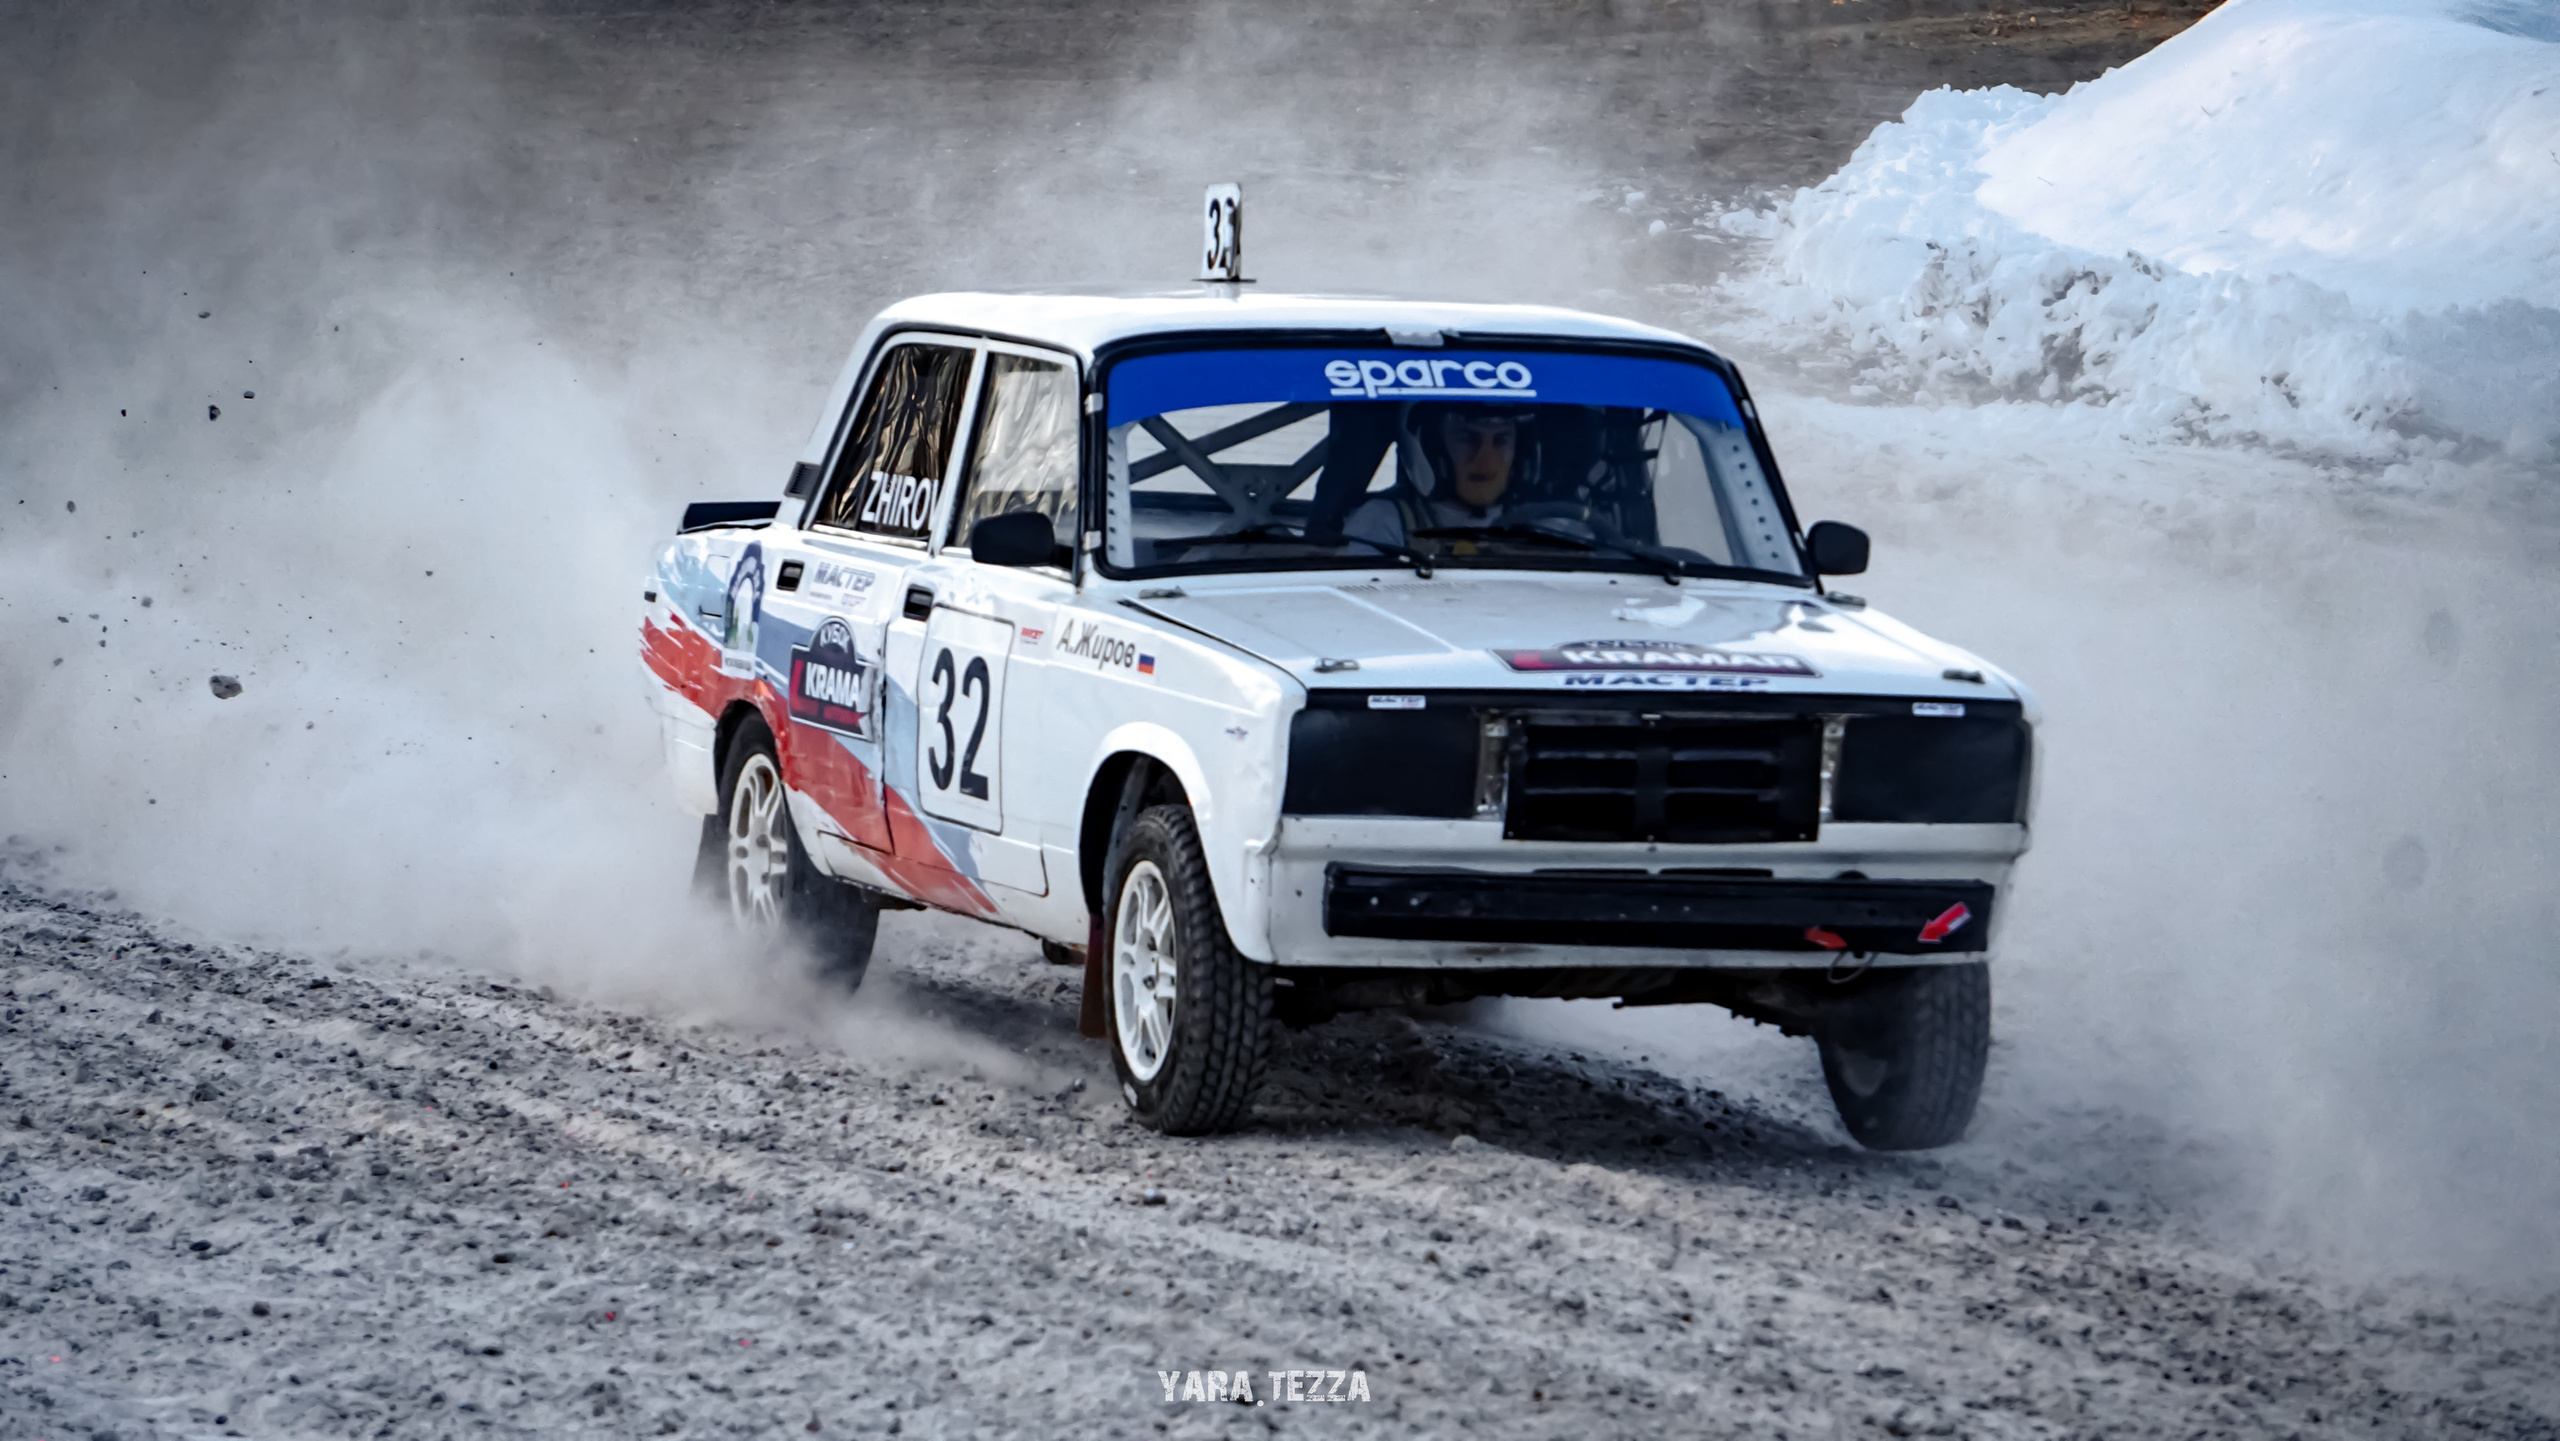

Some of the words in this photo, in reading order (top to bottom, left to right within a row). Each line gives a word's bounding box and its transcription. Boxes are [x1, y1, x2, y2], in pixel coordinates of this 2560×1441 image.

[1324, 359, 1533, 398] sparco
[1564, 673, 1769, 687] МАСТЕР
[928, 647, 990, 801] 32
